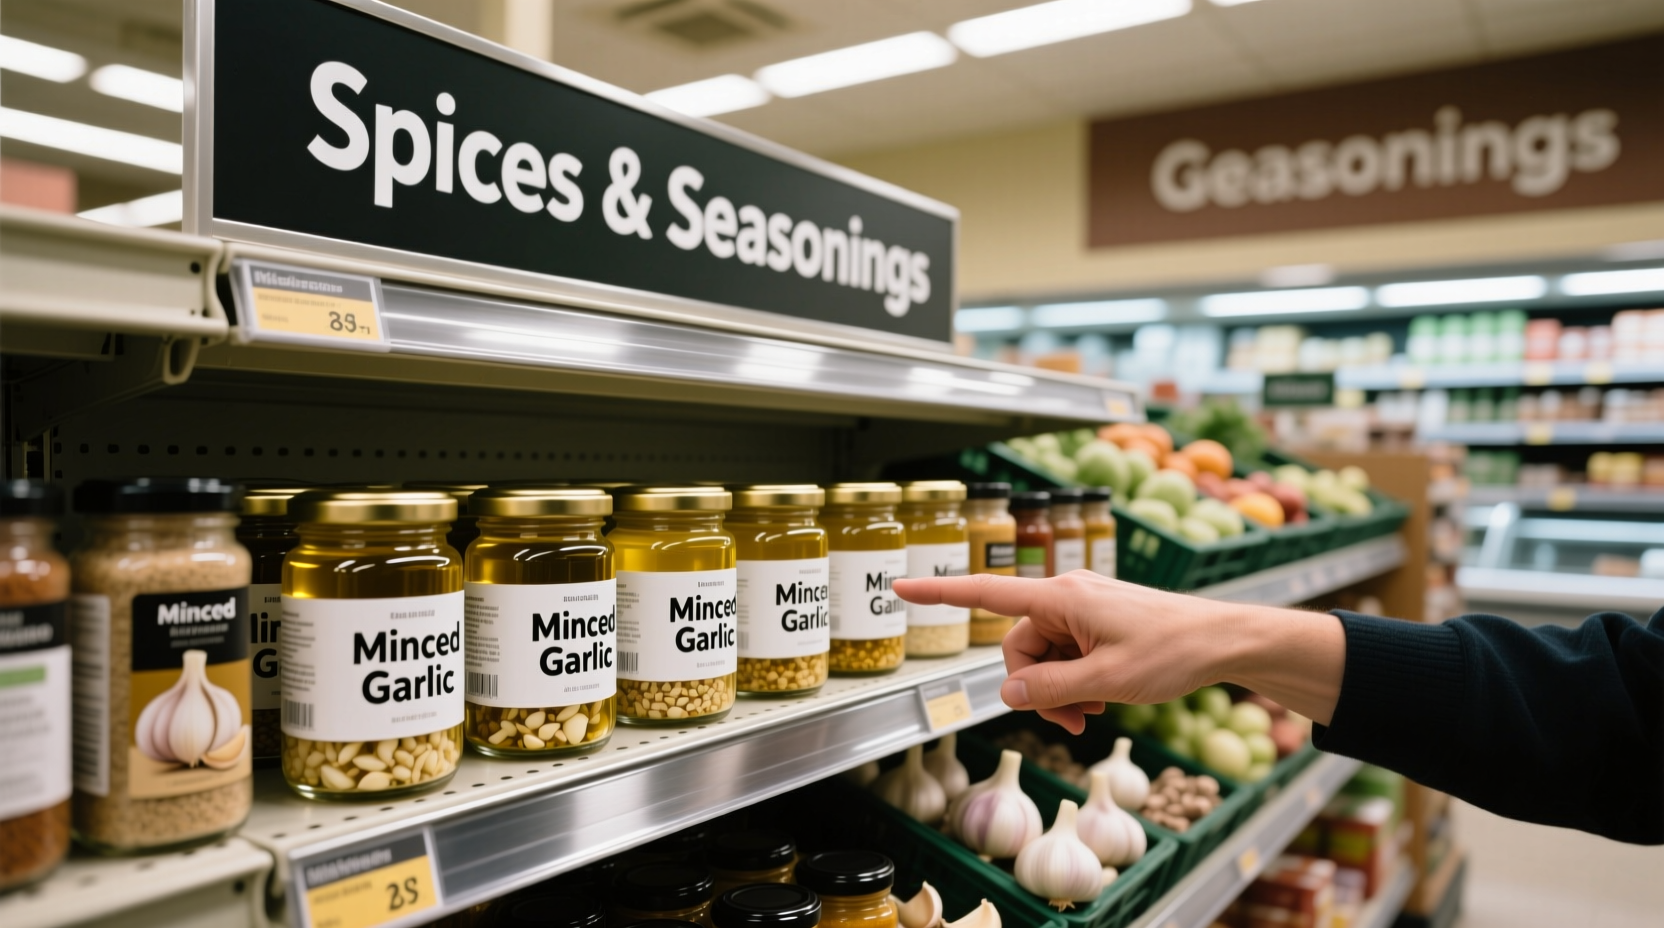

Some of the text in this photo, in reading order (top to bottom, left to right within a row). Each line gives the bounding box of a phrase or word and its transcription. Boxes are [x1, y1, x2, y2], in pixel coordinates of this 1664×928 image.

[1149, 104, 1622, 214] Geasonings
[307, 60, 931, 318] Spices & Seasonings
[157, 596, 237, 626] Minced
[669, 590, 738, 623] Minced
[775, 580, 829, 606] Mince
[531, 604, 616, 642] Minced
[674, 622, 735, 653] Garlic
[353, 620, 460, 665] Minced
[539, 642, 613, 677] Garlic
[361, 663, 455, 705] Garlic
